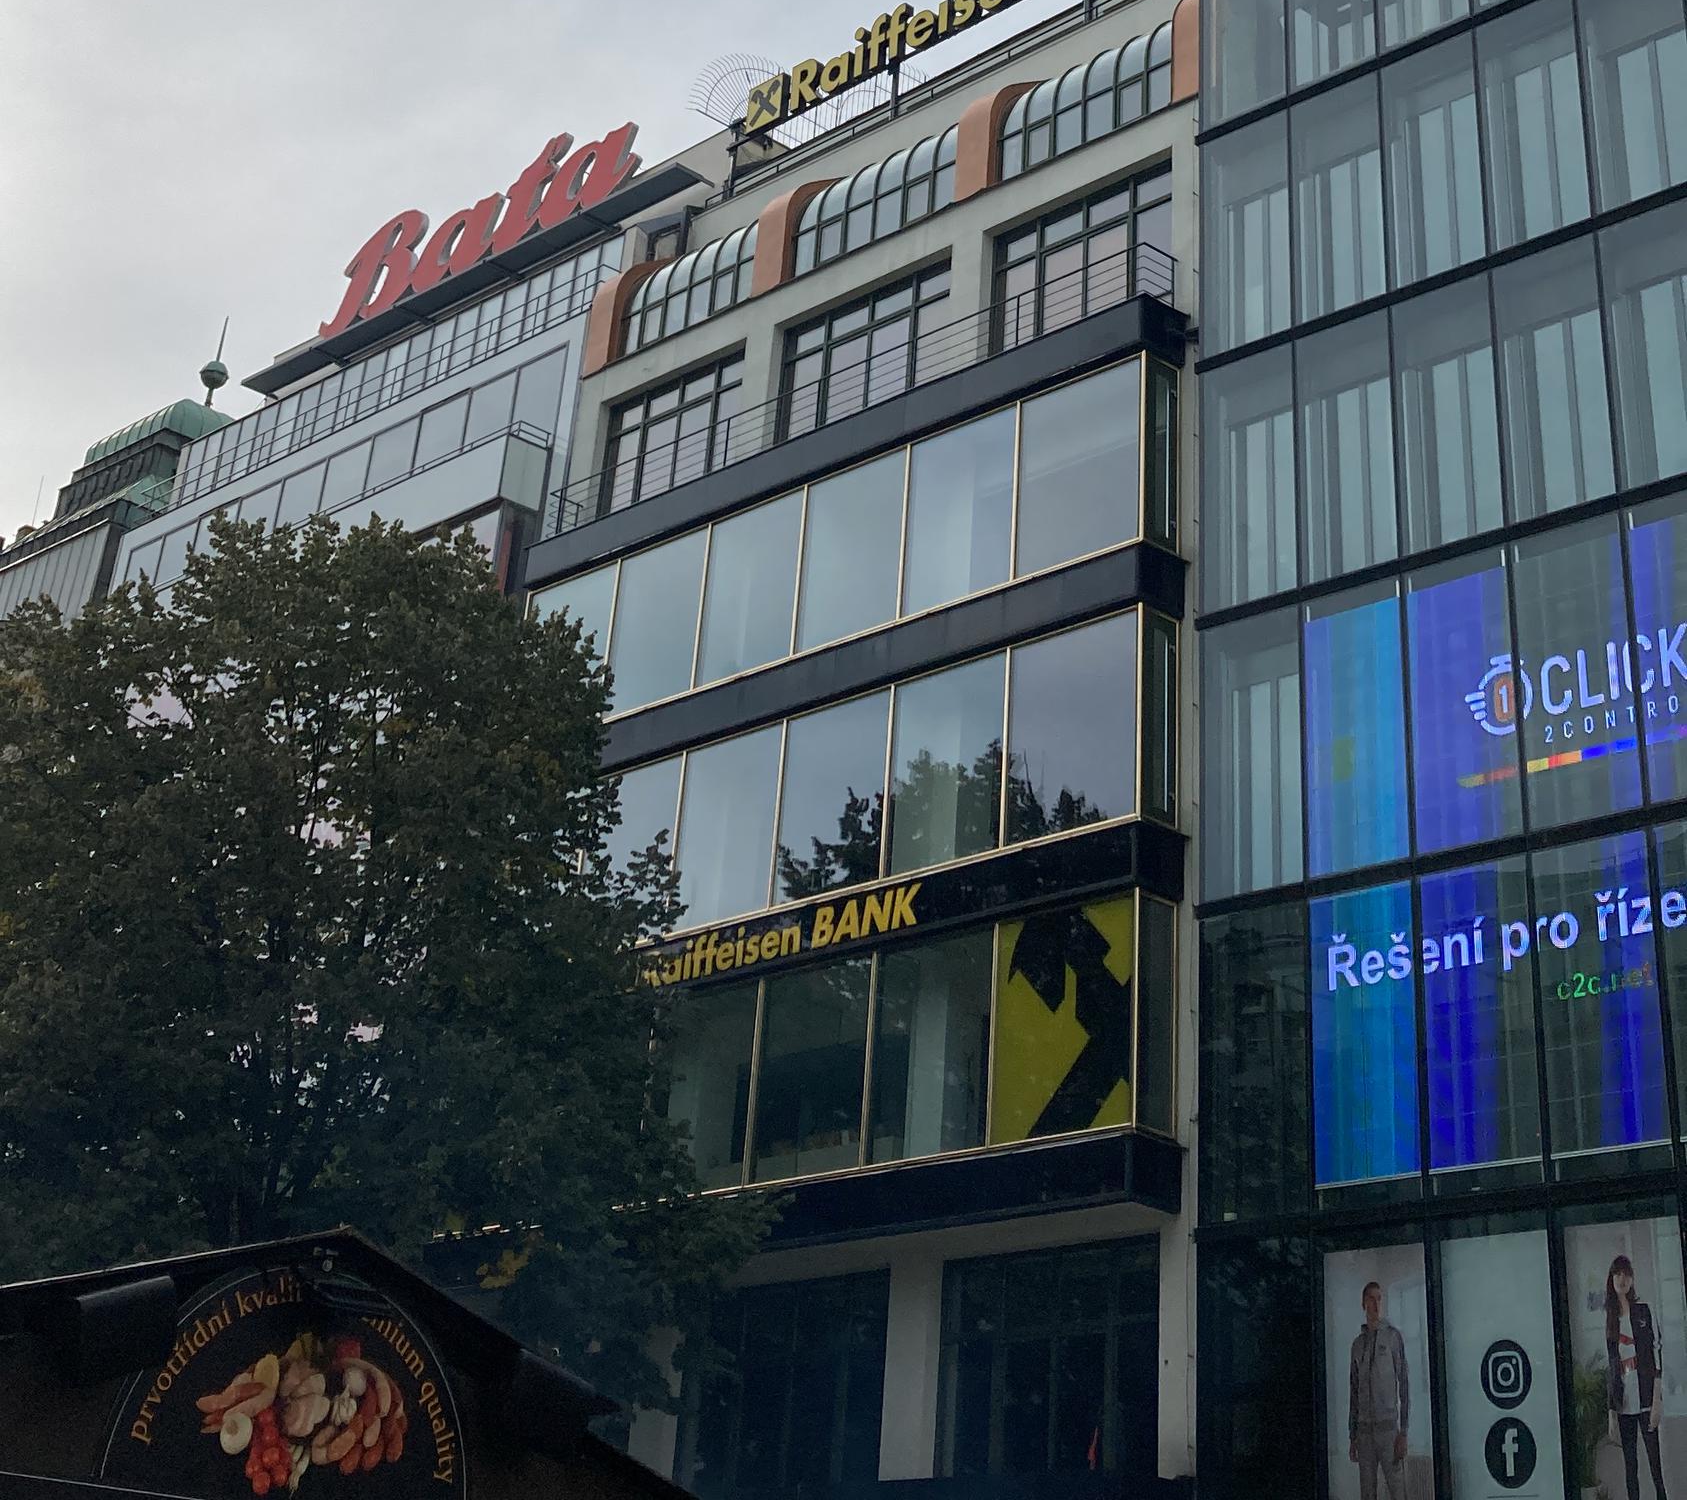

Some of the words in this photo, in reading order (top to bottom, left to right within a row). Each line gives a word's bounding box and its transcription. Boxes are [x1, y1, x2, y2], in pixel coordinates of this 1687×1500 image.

[1540, 622, 1687, 716] CLICK
[811, 882, 922, 949] BANK
[1327, 916, 1486, 992] Řešení
[1501, 912, 1579, 971] pro
[1594, 887, 1687, 942] říze
[418, 1378, 455, 1485] quality
